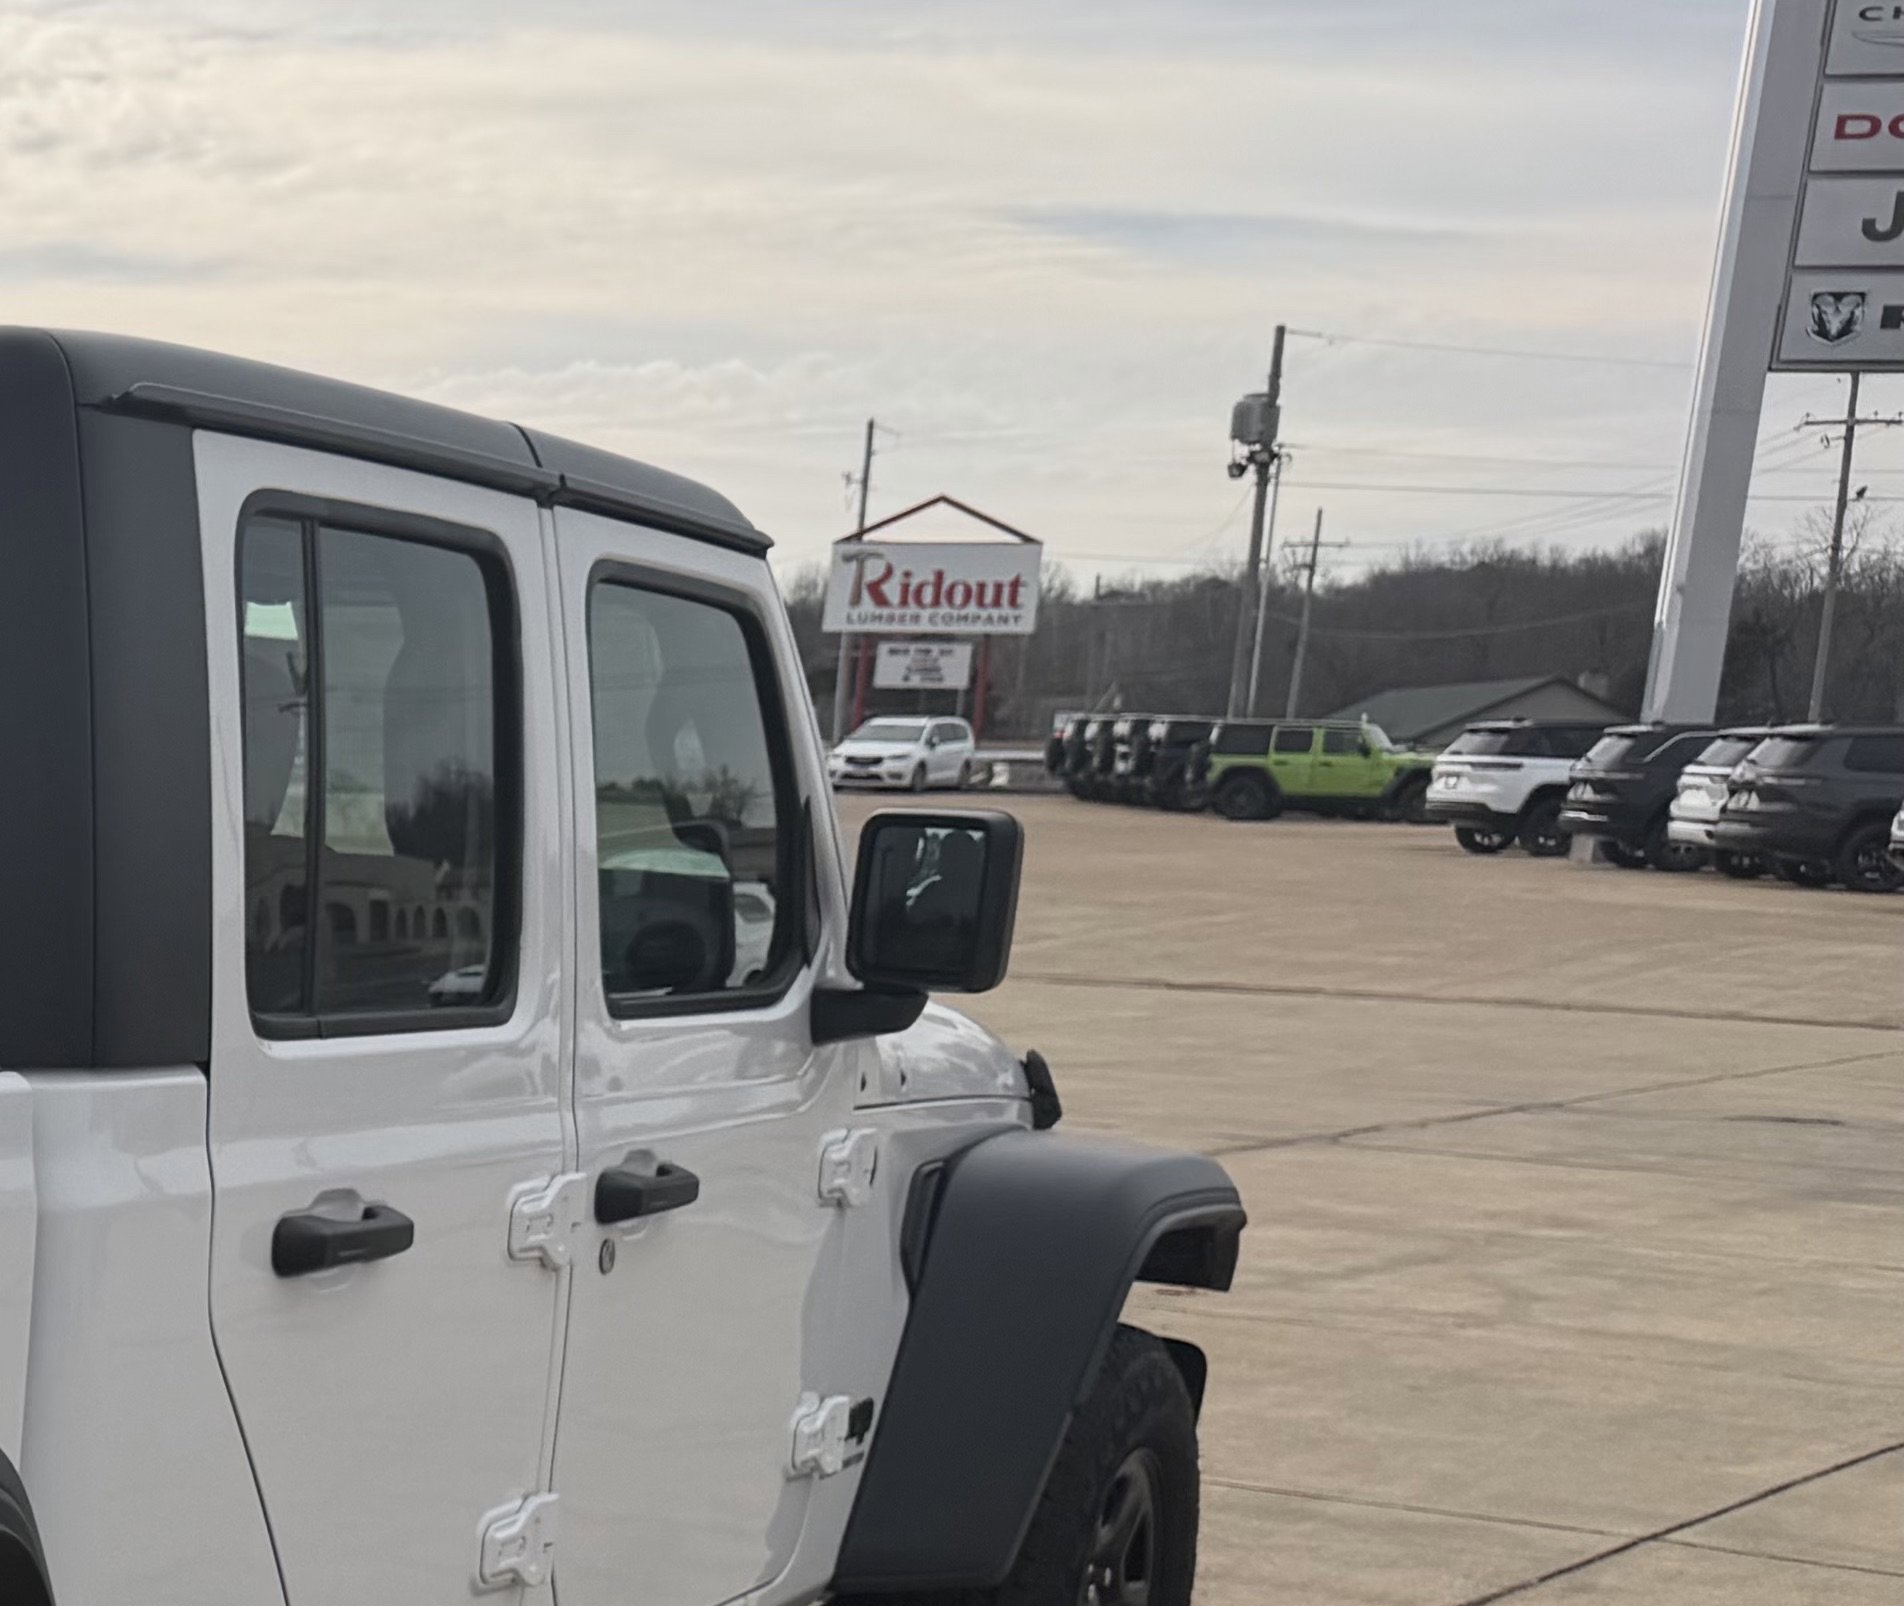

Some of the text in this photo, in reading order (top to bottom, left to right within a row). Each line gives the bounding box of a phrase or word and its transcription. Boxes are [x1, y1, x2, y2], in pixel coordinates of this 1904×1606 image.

[841, 551, 1028, 610] Ridout
[846, 611, 1024, 626] LUMBER COMPANY
